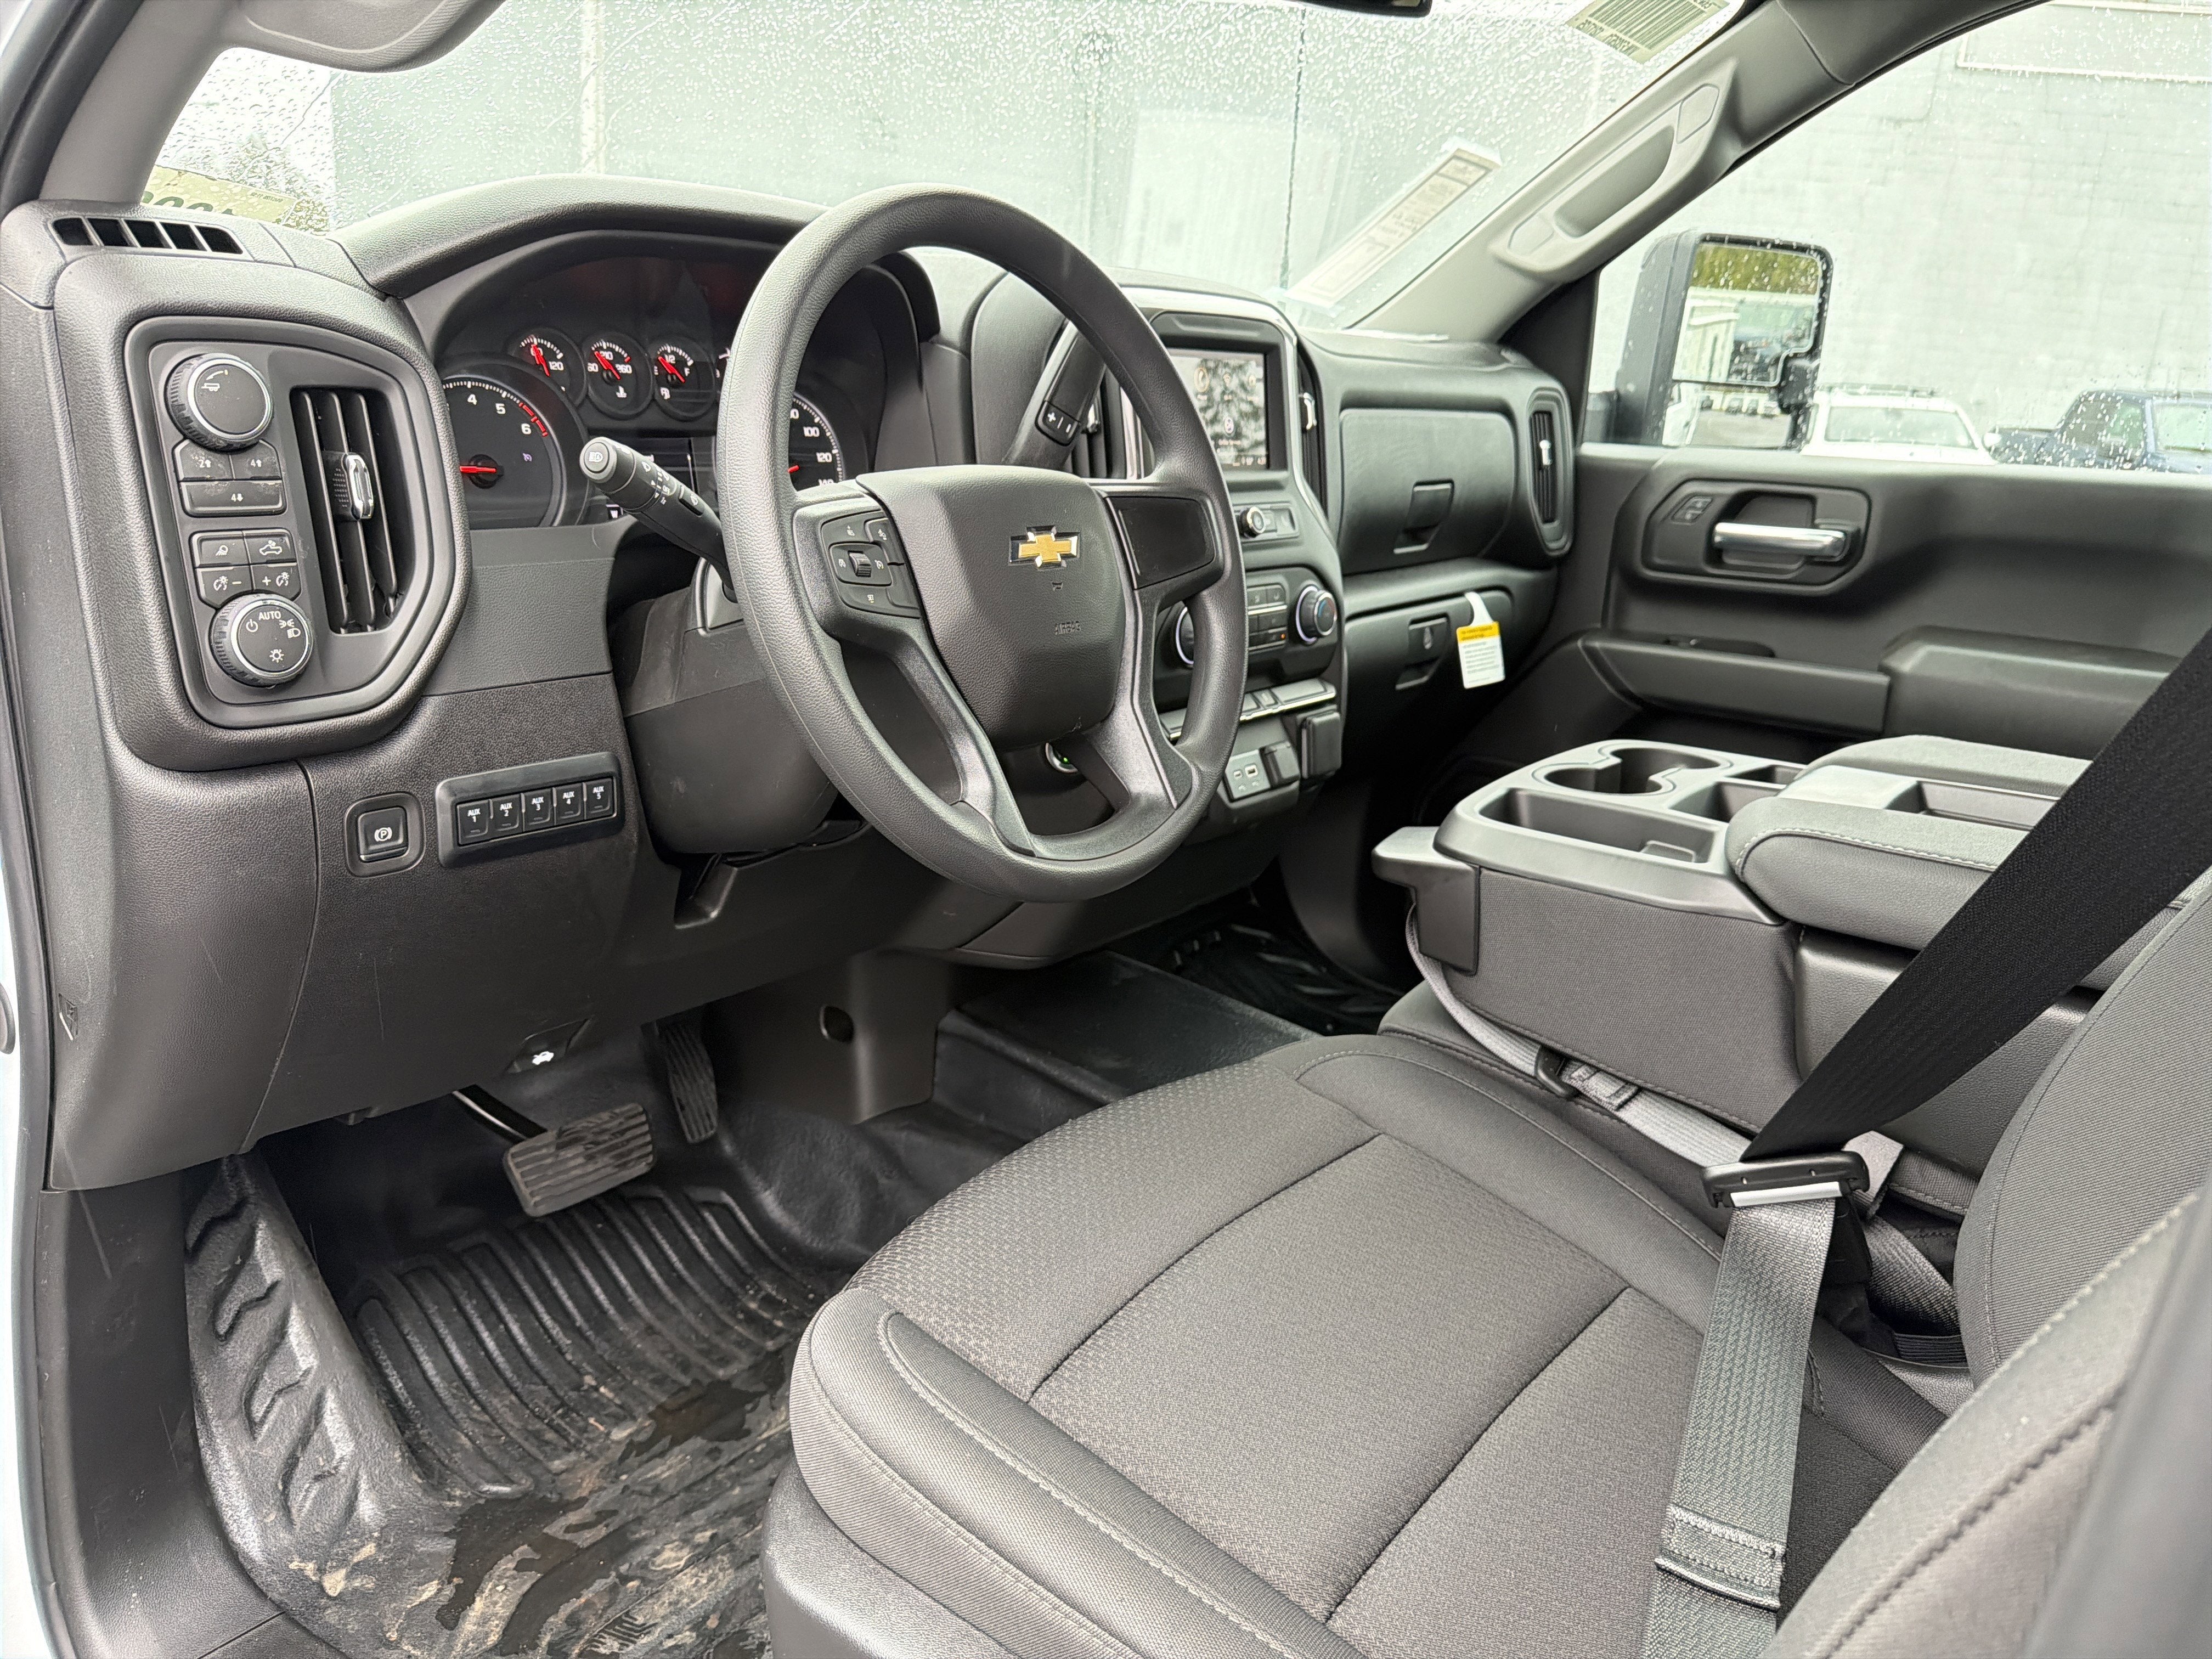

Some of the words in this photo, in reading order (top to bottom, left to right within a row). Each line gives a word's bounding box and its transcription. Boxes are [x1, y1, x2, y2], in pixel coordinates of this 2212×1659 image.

[549, 361, 564, 371] 120
[684, 368, 690, 376] F
[467, 394, 477, 405] 4
[495, 403, 506, 414] 5
[521, 424, 532, 435] 6
[803, 426, 820, 437] 100
[816, 452, 832, 462] 120
[198, 460, 205, 468] 2
[250, 459, 256, 467] 4
[231, 493, 237, 502] 4
[258, 611, 281, 620] AUTO
[592, 786, 605, 794] AUX
[562, 791, 575, 799] AUX
[531, 797, 544, 805] AUX
[500, 803, 513, 811] AUX
[467, 808, 481, 817] AUX
